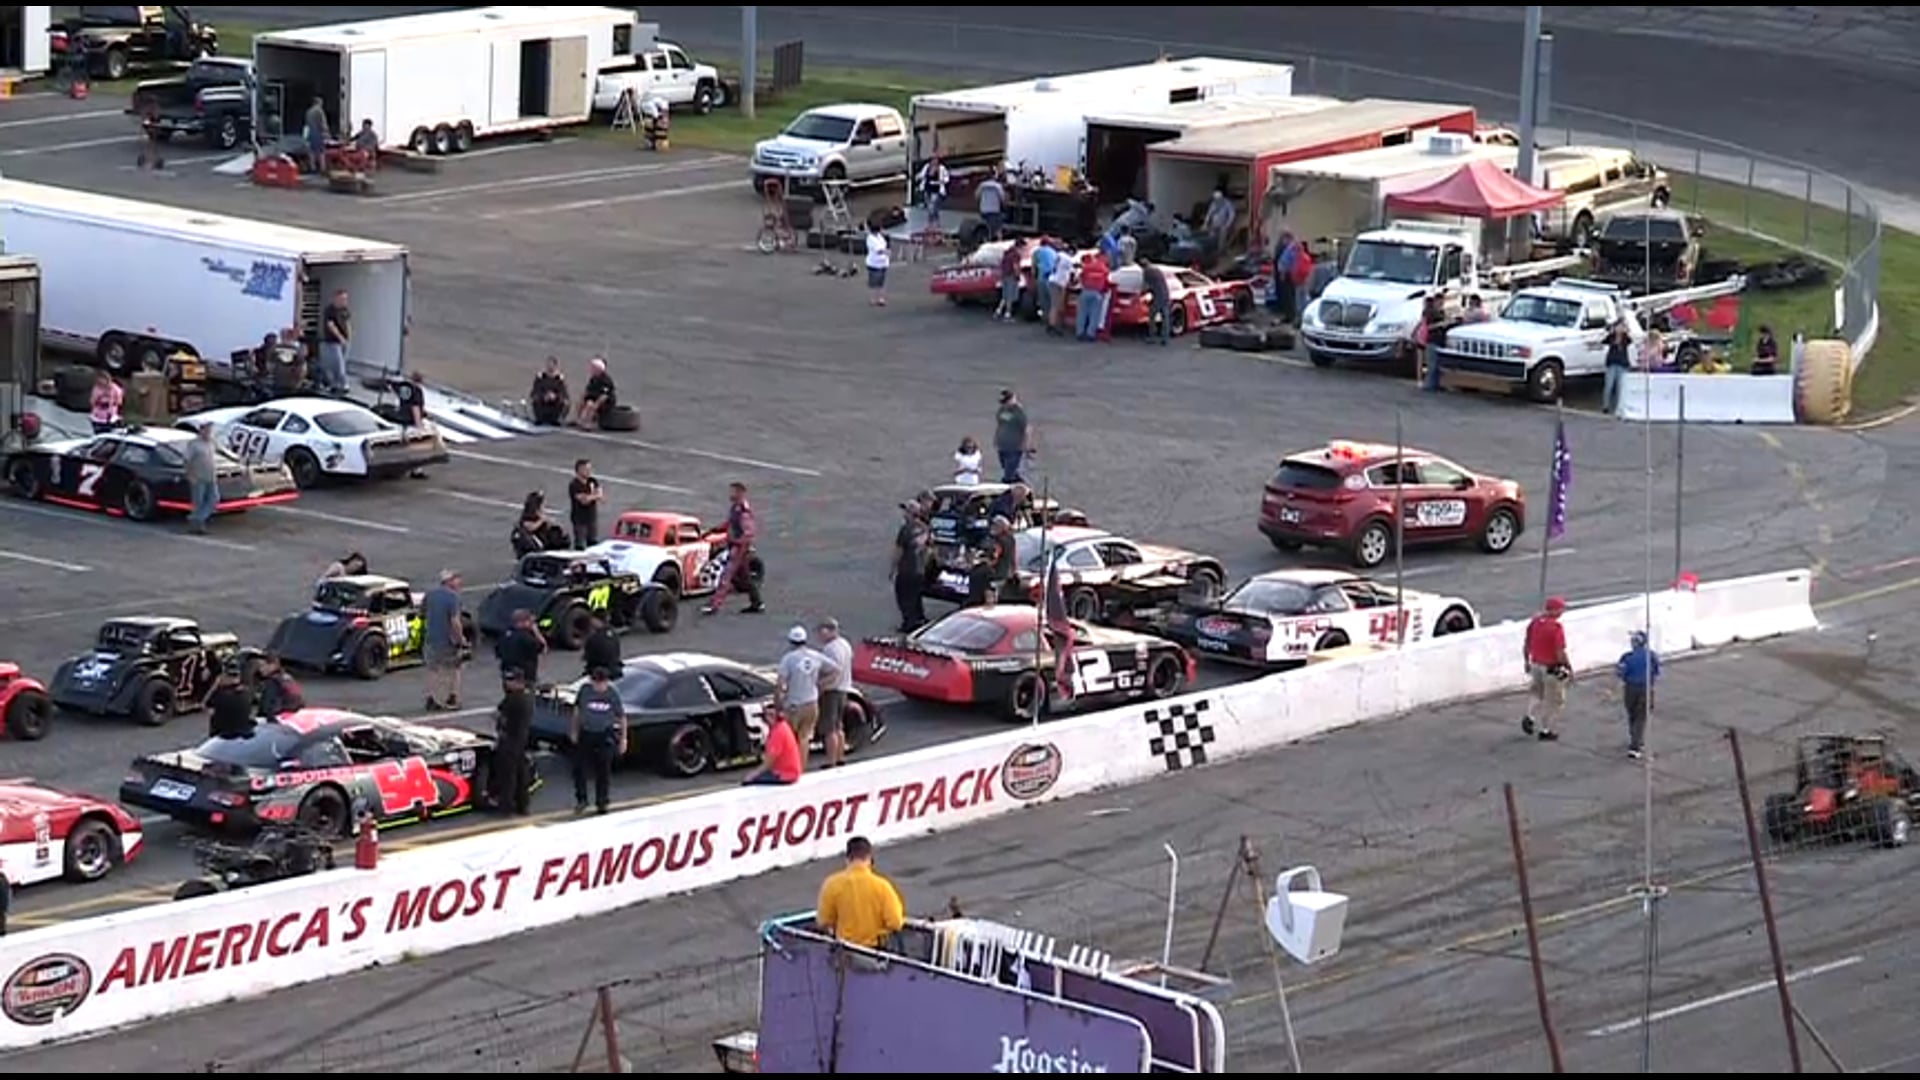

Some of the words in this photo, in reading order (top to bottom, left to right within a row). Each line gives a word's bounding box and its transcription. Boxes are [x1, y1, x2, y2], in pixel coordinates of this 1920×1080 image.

[1196, 289, 1217, 317] 6
[78, 464, 105, 496] 7
[370, 756, 440, 815] 54
[95, 897, 373, 995] AMERICA'S
[385, 867, 521, 933] MOST
[533, 825, 717, 900] FAMOUS
[731, 794, 868, 859] SHORT
[877, 764, 1000, 826] TRACK
